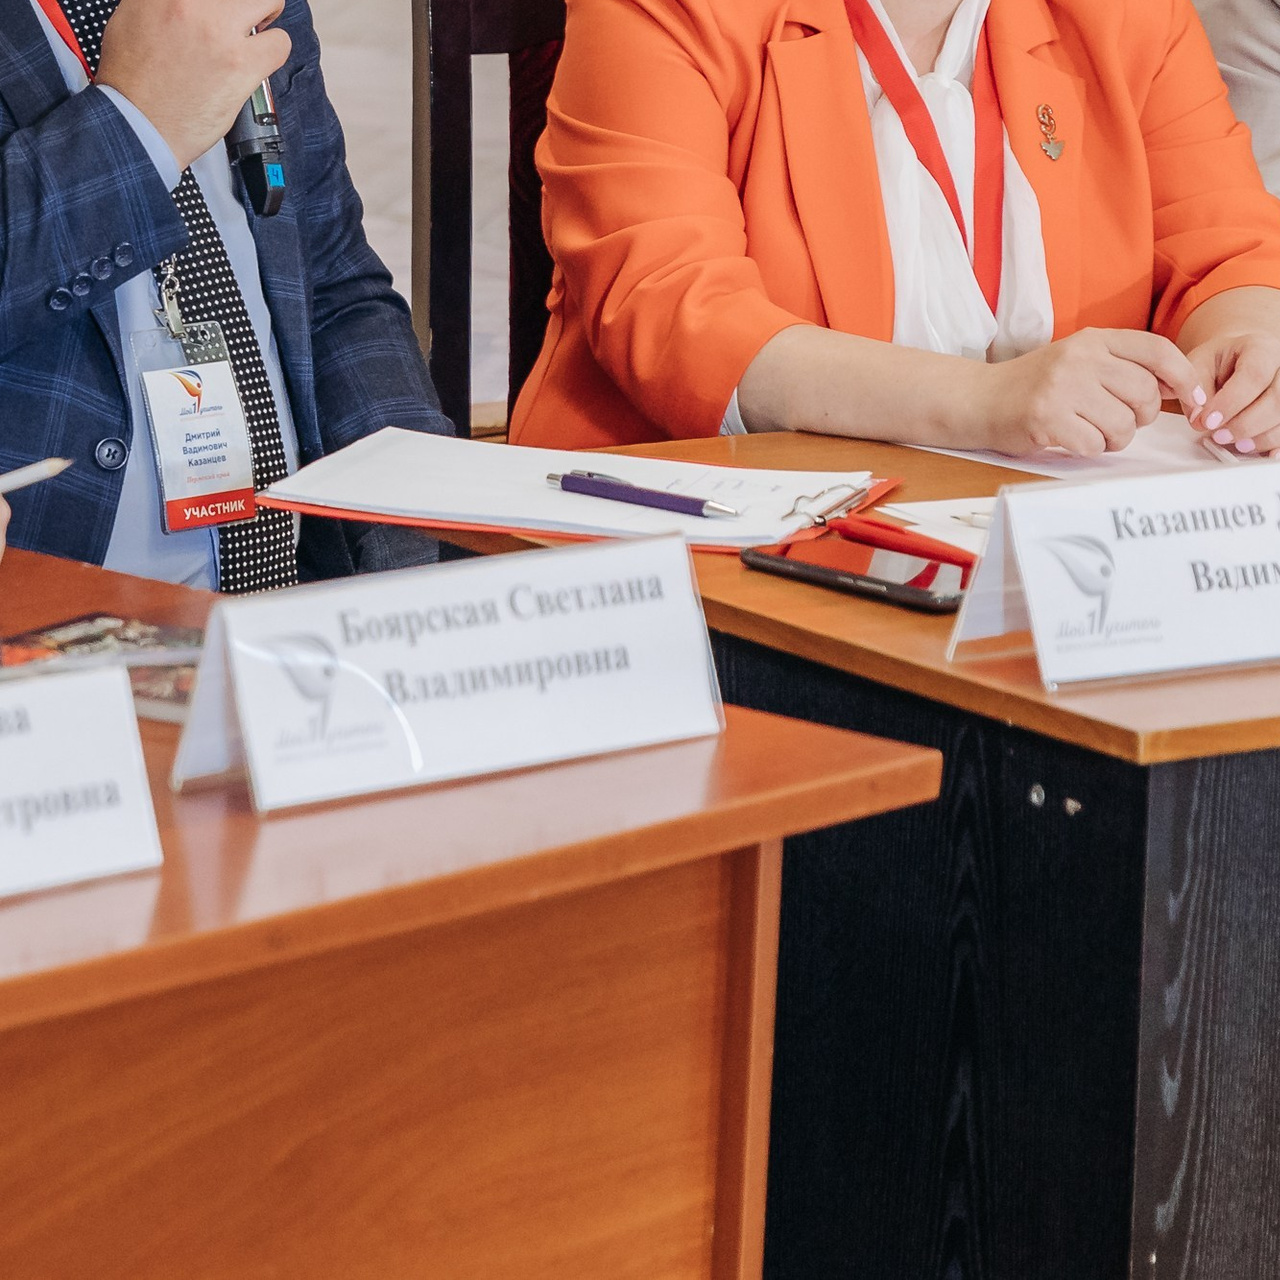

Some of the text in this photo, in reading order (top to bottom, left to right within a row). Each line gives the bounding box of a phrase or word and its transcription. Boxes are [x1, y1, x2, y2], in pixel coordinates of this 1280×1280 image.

[185, 428, 221, 443] Дмитрий
[182, 442, 228, 455] Вадимович
[188, 455, 227, 467] Казанцев
[183, 499, 246, 520] УЧАСТНИК
[1110, 503, 1266, 540] Казанцев
[337, 574, 665, 646] Боярская Светлана
[383, 644, 631, 705] Владимировна
